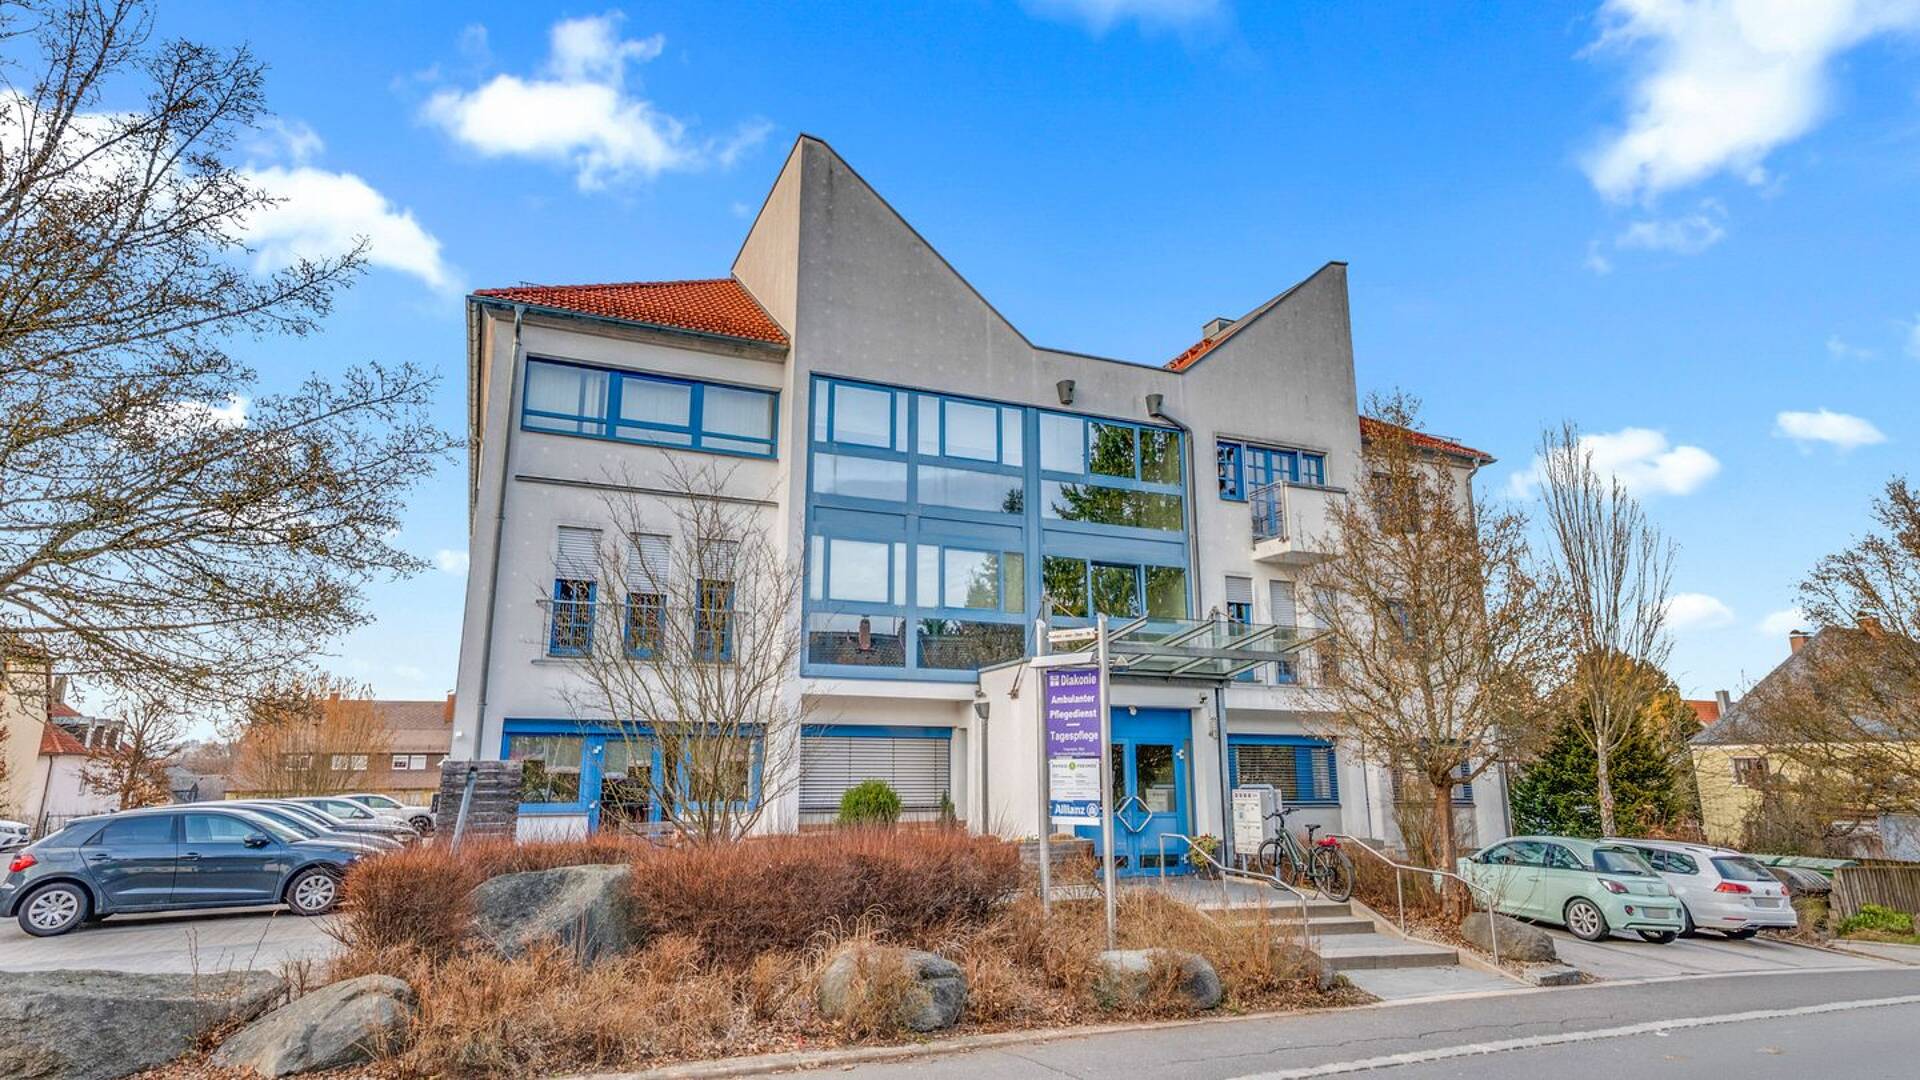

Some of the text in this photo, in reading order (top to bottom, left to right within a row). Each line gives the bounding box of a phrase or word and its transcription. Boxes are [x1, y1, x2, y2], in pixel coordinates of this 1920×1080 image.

[1061, 673, 1096, 686] Diakonie
[1051, 694, 1095, 704] Ambulanter
[1049, 709, 1097, 720] Pflegedienst
[1050, 730, 1098, 743] Tagespflege
[1054, 803, 1085, 815] Allianz
